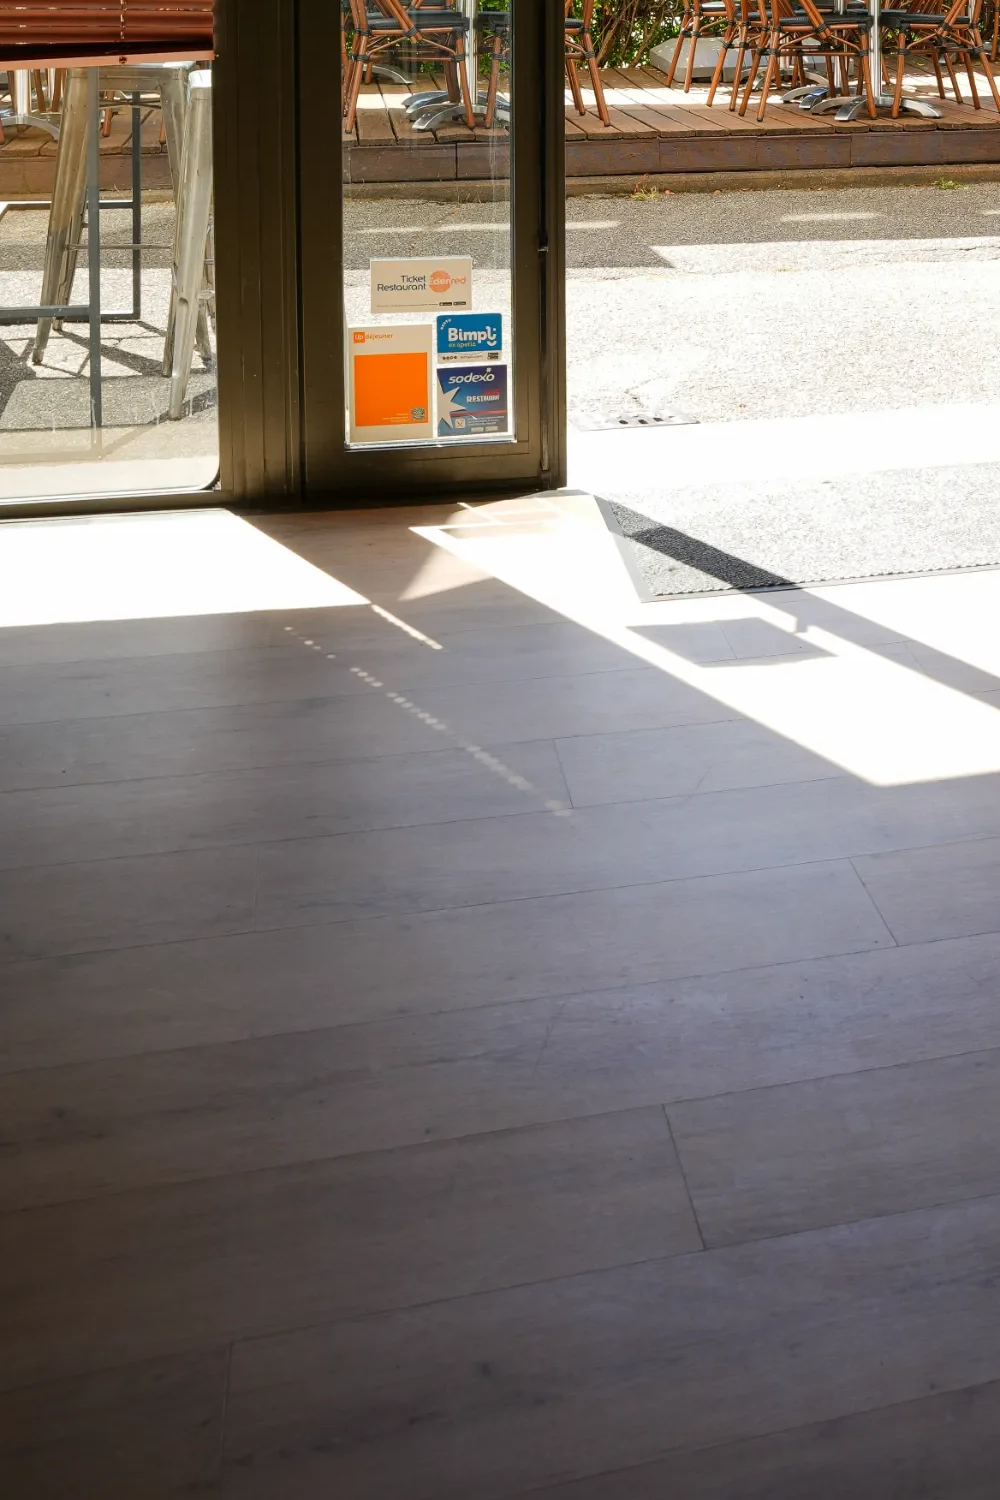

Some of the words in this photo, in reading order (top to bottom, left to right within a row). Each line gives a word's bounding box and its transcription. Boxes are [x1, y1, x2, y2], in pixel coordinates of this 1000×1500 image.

[401, 275, 426, 283] Ticket
[377, 283, 426, 291] Restaurant
[448, 326, 497, 346] Bimpli
[448, 372, 495, 384] sodexo
